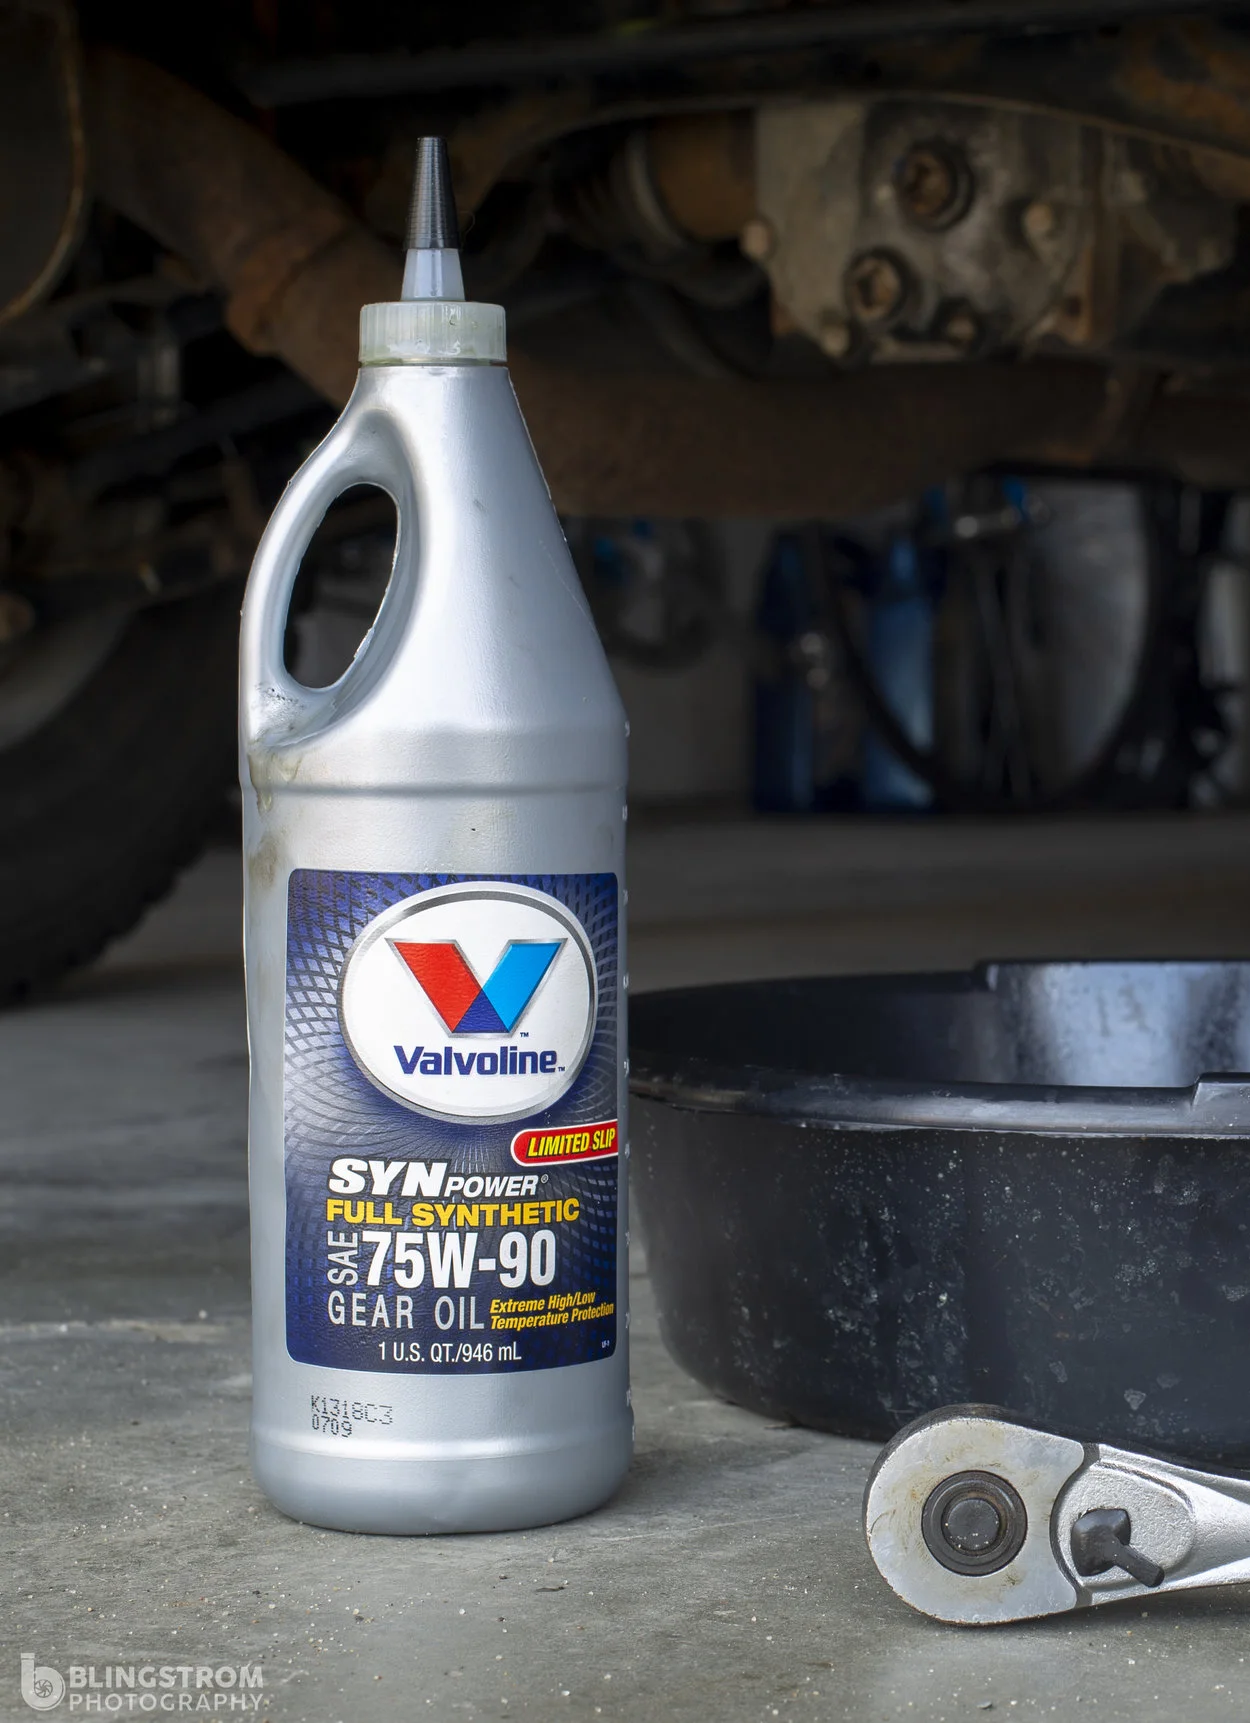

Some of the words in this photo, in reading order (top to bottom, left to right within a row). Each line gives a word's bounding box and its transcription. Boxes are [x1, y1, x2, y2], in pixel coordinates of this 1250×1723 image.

[393, 1045, 557, 1077] Valvoline
[527, 1132, 590, 1158] LIMITED
[592, 1127, 616, 1150] SLIP
[325, 1199, 403, 1225] FULL
[411, 1197, 580, 1227] SYNTHETIC
[327, 1230, 358, 1286] SAE
[361, 1228, 557, 1289] 75W-90
[327, 1290, 414, 1330] GEAR
[434, 1295, 485, 1331] OIL
[489, 1298, 545, 1314] Extreme
[547, 1291, 596, 1311] High/Low
[490, 1311, 569, 1332] Temperature
[570, 1302, 615, 1323] Protection
[378, 1342, 386, 1360] 1
[392, 1342, 425, 1361] U.S.
[430, 1342, 493, 1362] QT./946
[498, 1341, 522, 1361] mL
[311, 1413, 353, 1438] 0709
